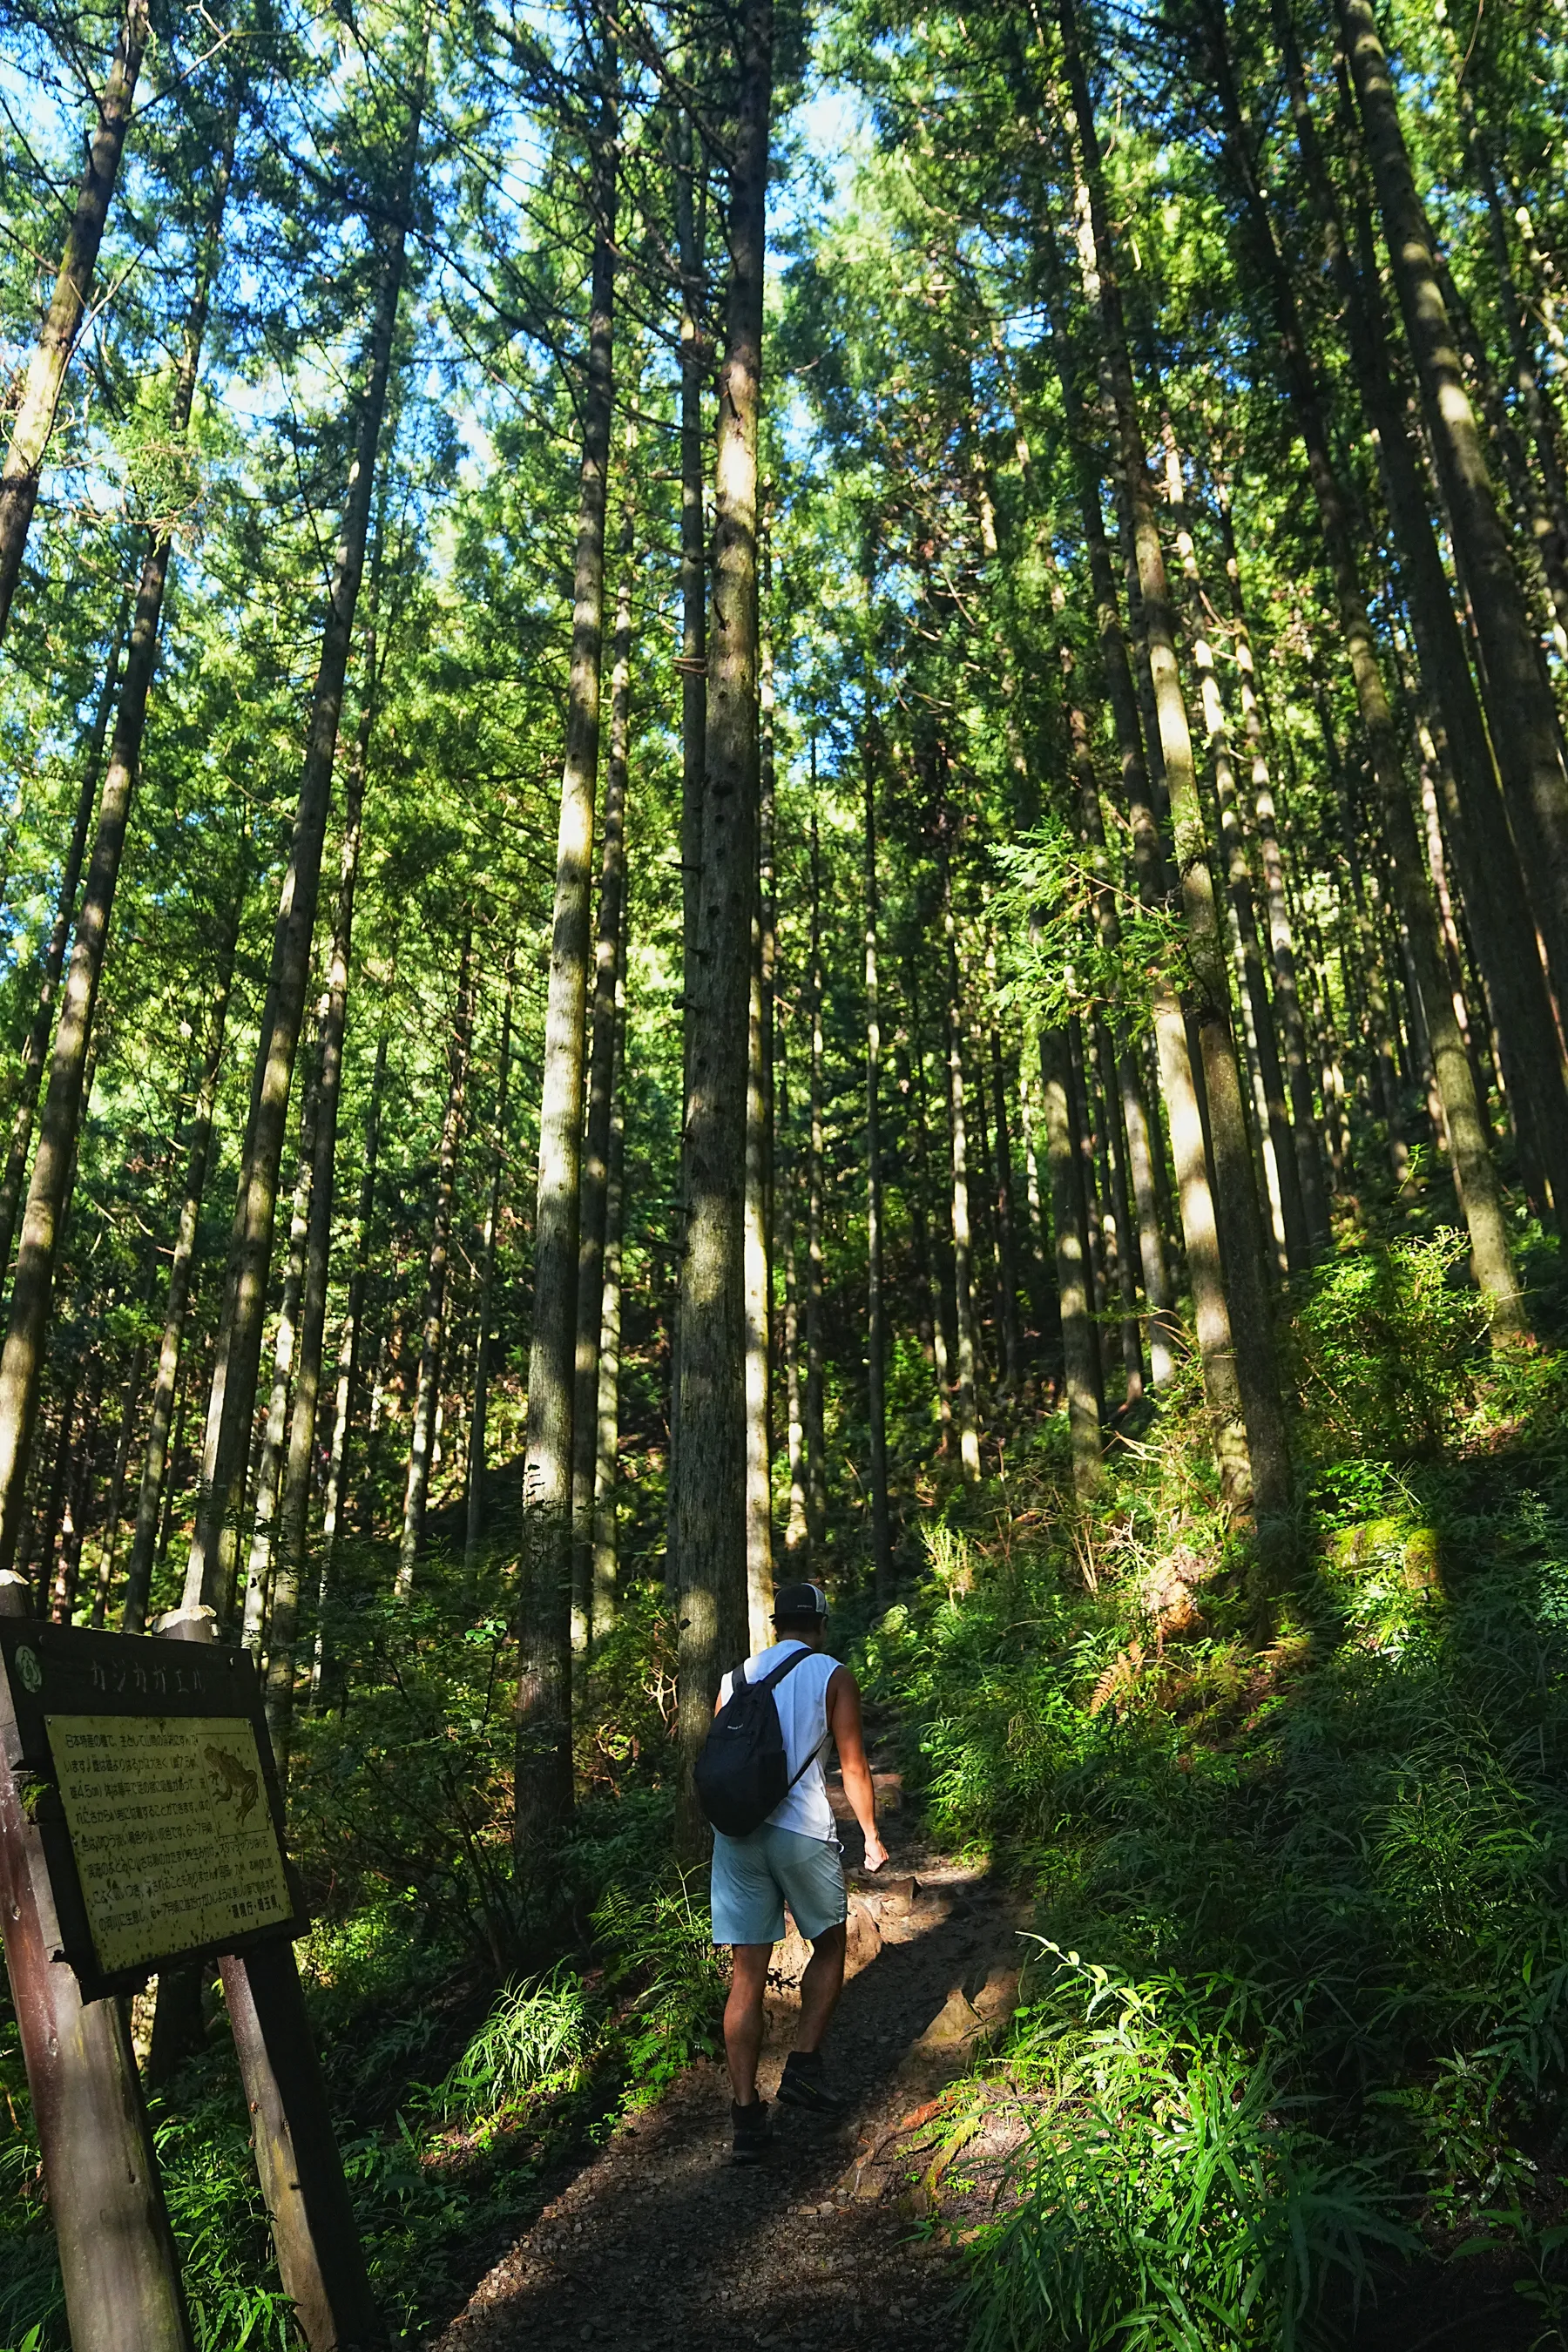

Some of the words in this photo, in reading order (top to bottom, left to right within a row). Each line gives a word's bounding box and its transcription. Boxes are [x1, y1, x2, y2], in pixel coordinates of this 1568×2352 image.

[90, 1656, 206, 1695] カジカガエル
